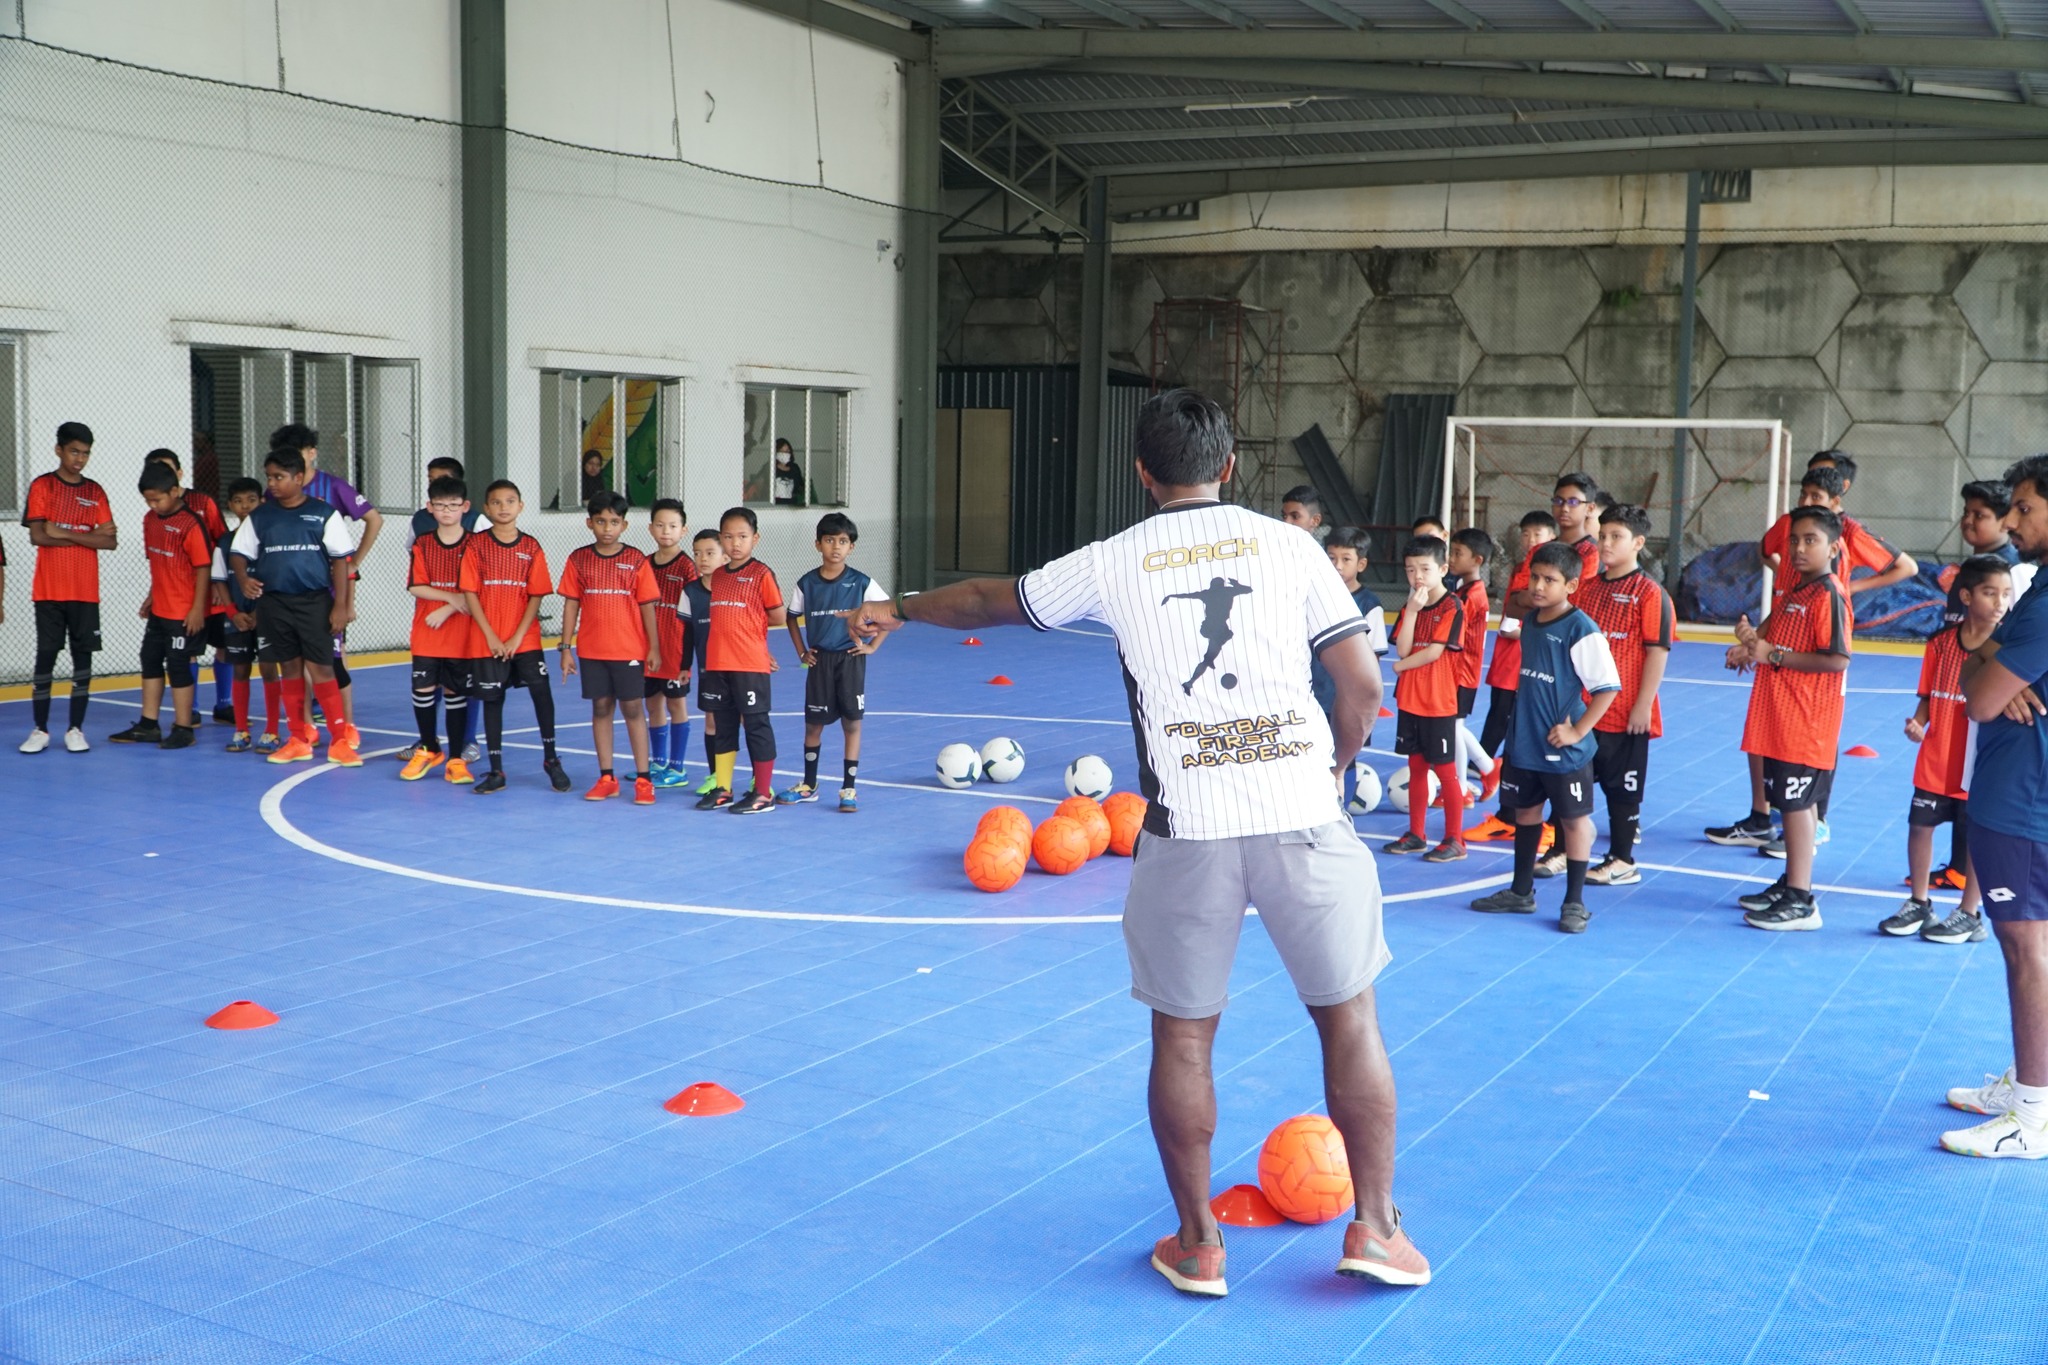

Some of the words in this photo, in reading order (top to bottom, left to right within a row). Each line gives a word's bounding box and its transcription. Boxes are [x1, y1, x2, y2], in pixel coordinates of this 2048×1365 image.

[1143, 537, 1259, 572] COACH
[171, 636, 185, 650] 10
[1609, 631, 1628, 640] PRO
[1537, 671, 1555, 684] PRO
[747, 691, 756, 706] 3
[1164, 709, 1306, 738] FOOTBALL
[1198, 728, 1280, 752] FIRST
[1442, 738, 1448, 754] 1
[1182, 741, 1313, 769] ACADEMY
[1624, 770, 1638, 792] 5
[1785, 776, 1813, 800] 27
[1570, 782, 1583, 802] 4
